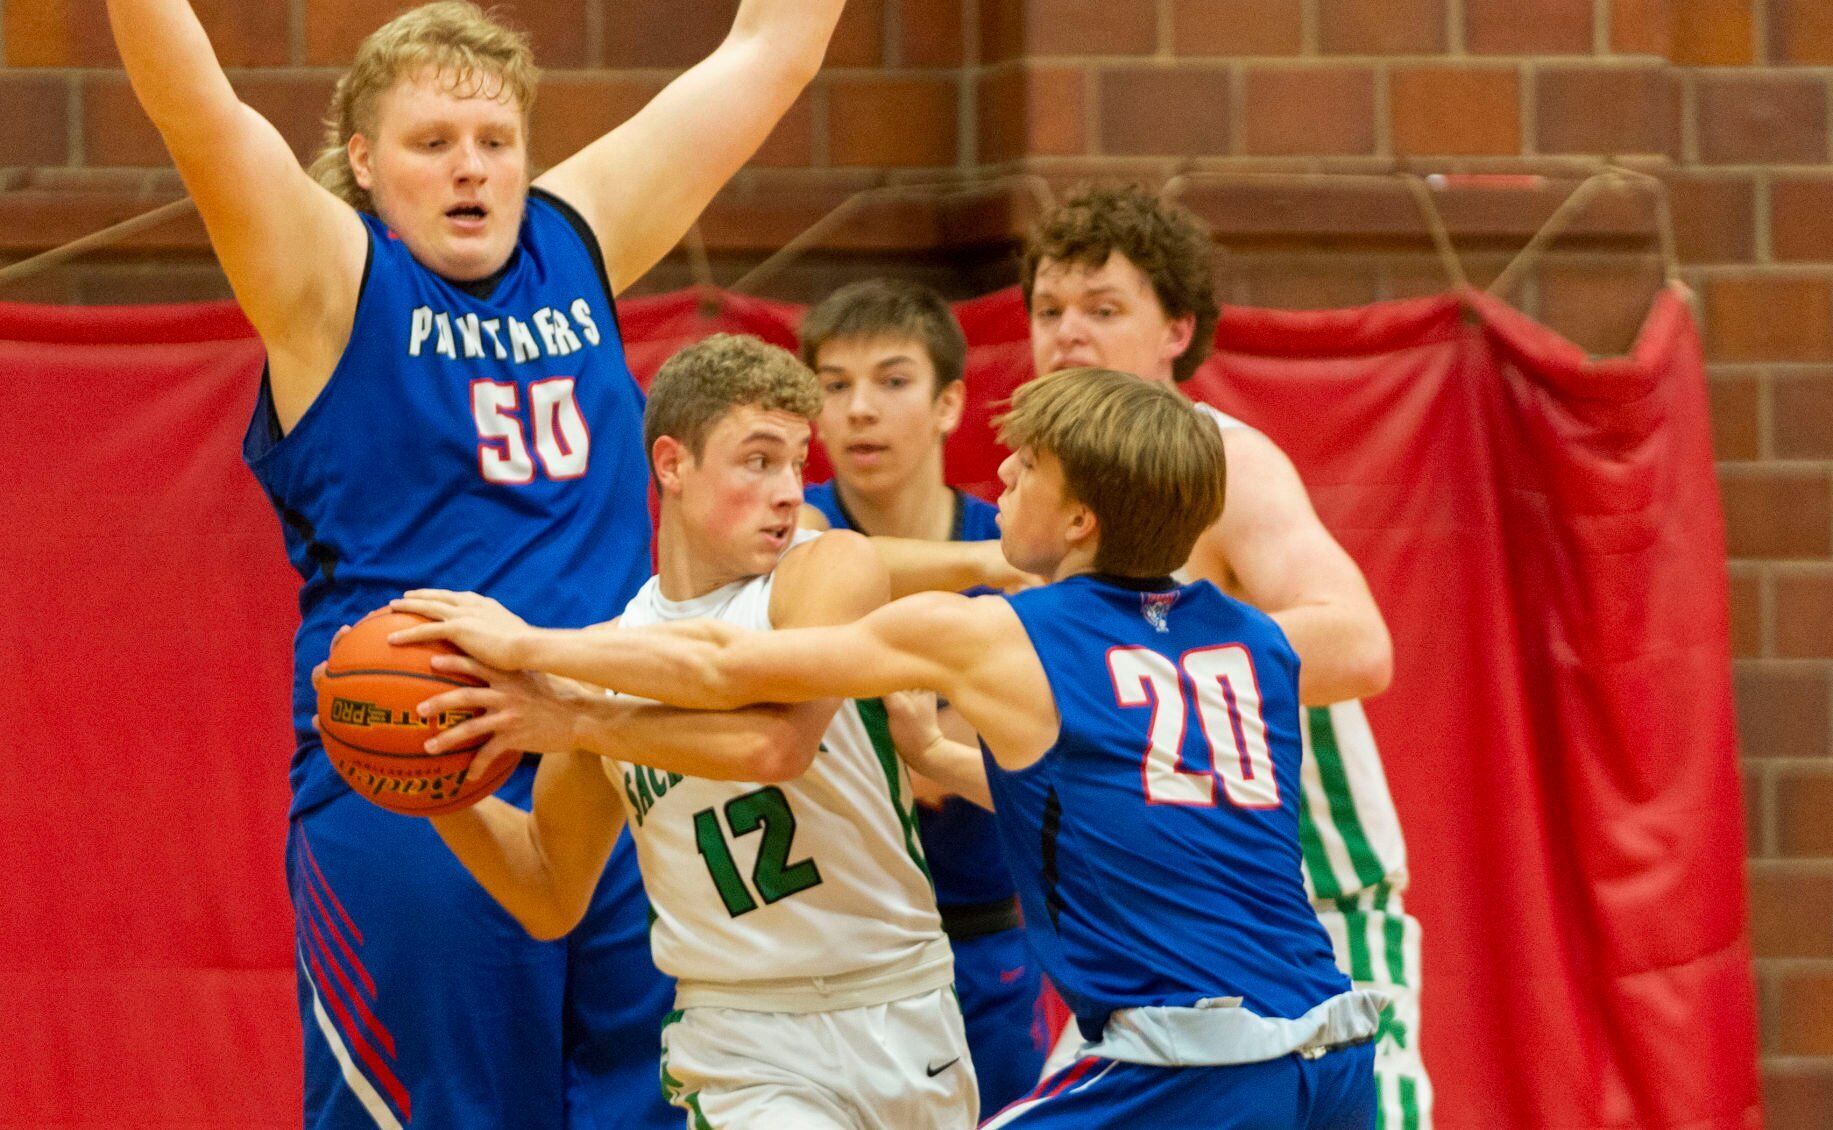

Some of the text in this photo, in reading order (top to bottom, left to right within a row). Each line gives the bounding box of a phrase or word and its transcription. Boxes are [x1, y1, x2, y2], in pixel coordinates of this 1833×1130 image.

[409, 298, 600, 364] PANTHERS
[469, 375, 591, 485] 50
[332, 700, 367, 725] PRO
[1105, 641, 1283, 811] 20
[692, 784, 824, 919] 12
